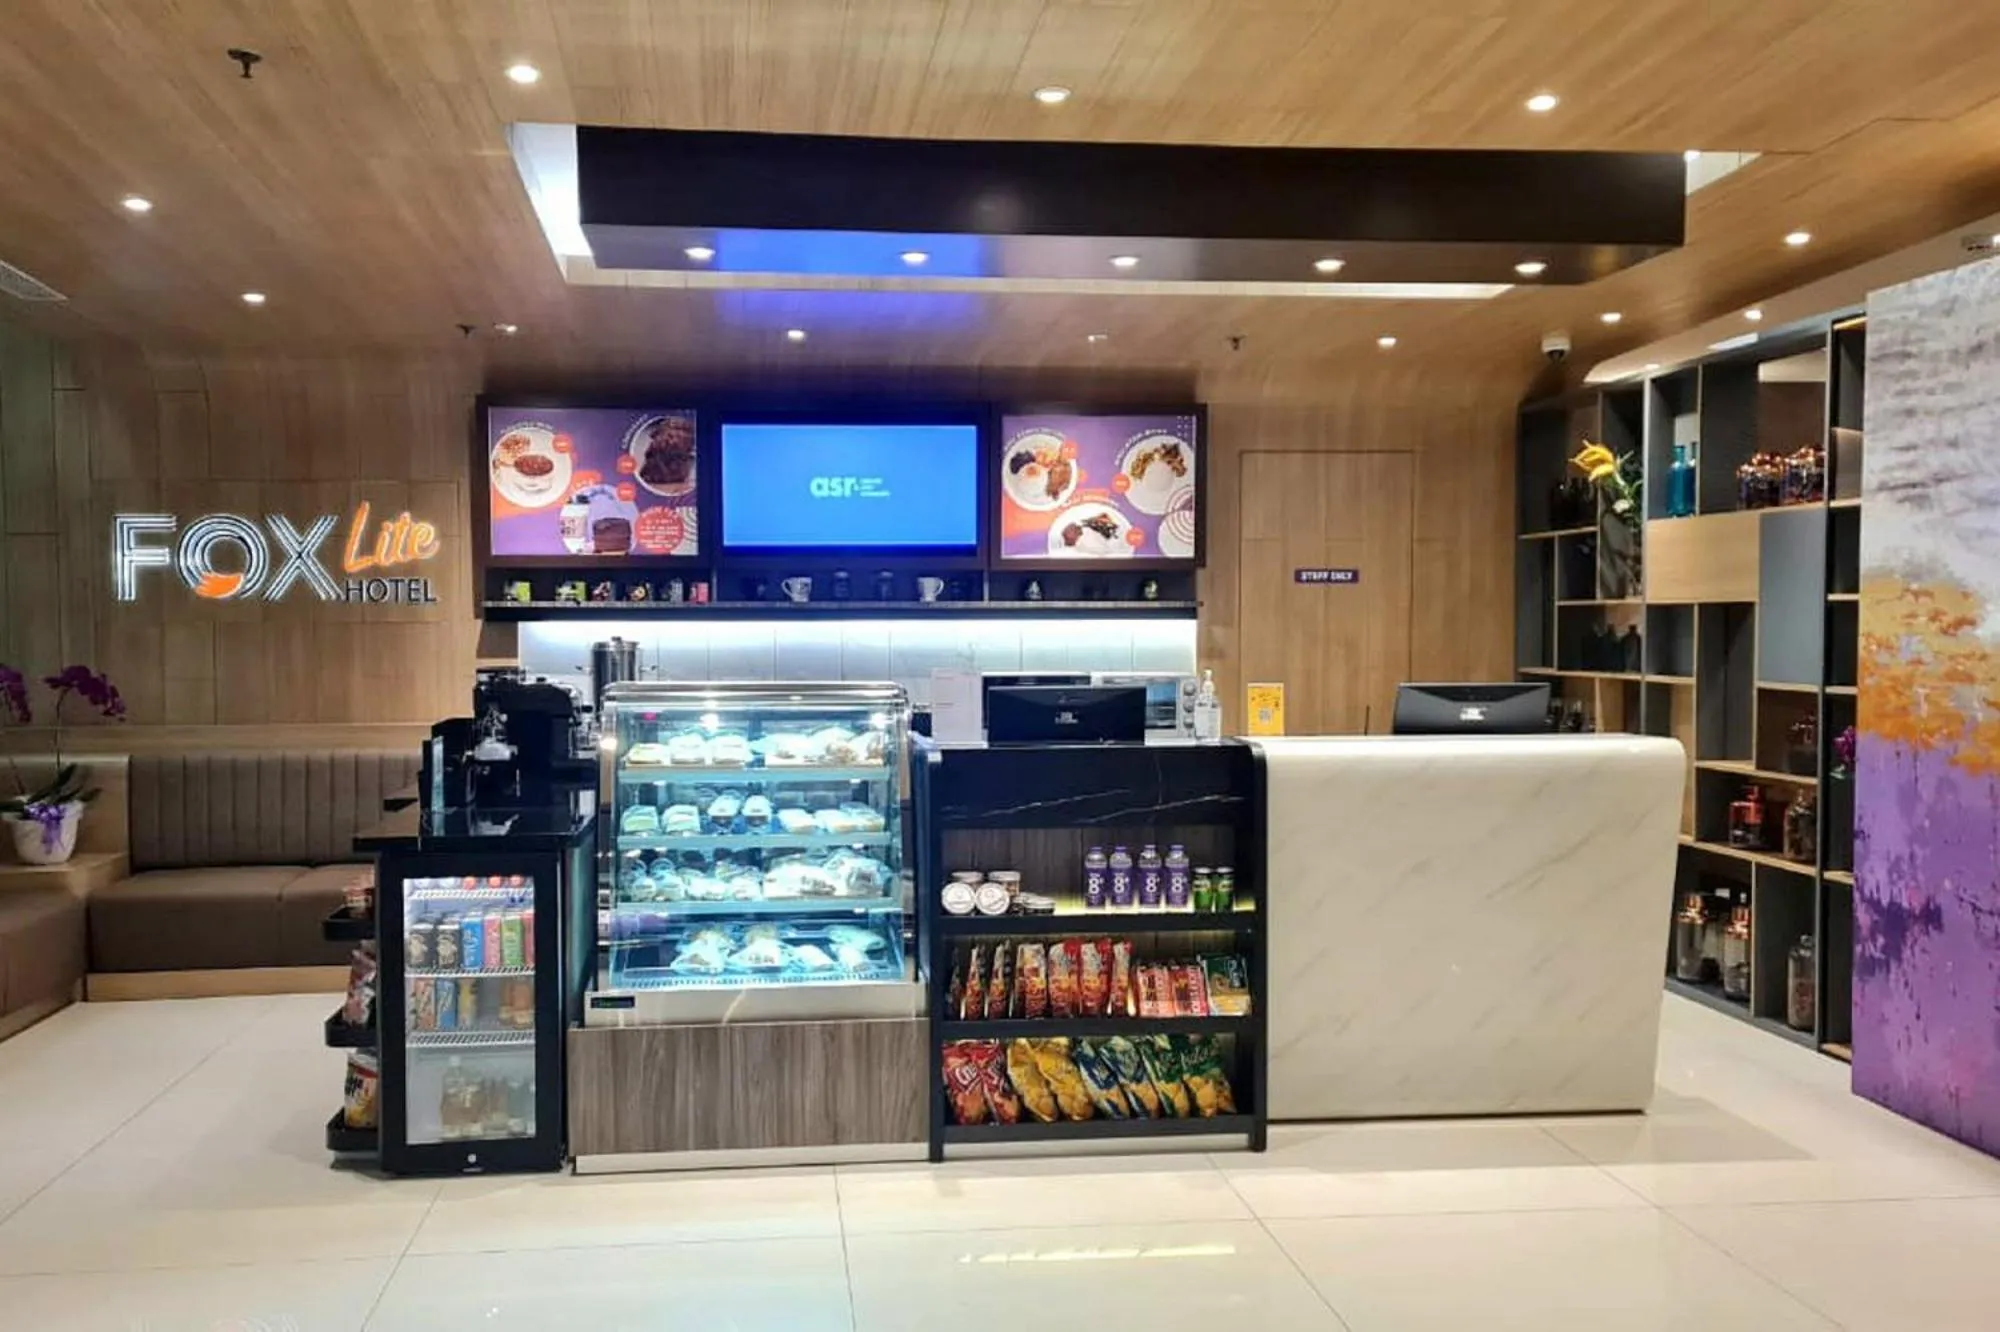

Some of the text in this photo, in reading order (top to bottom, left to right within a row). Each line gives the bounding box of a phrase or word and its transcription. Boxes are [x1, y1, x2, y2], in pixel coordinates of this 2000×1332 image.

[113, 500, 442, 602] FOX Lite
[345, 577, 437, 603] HOTEL
